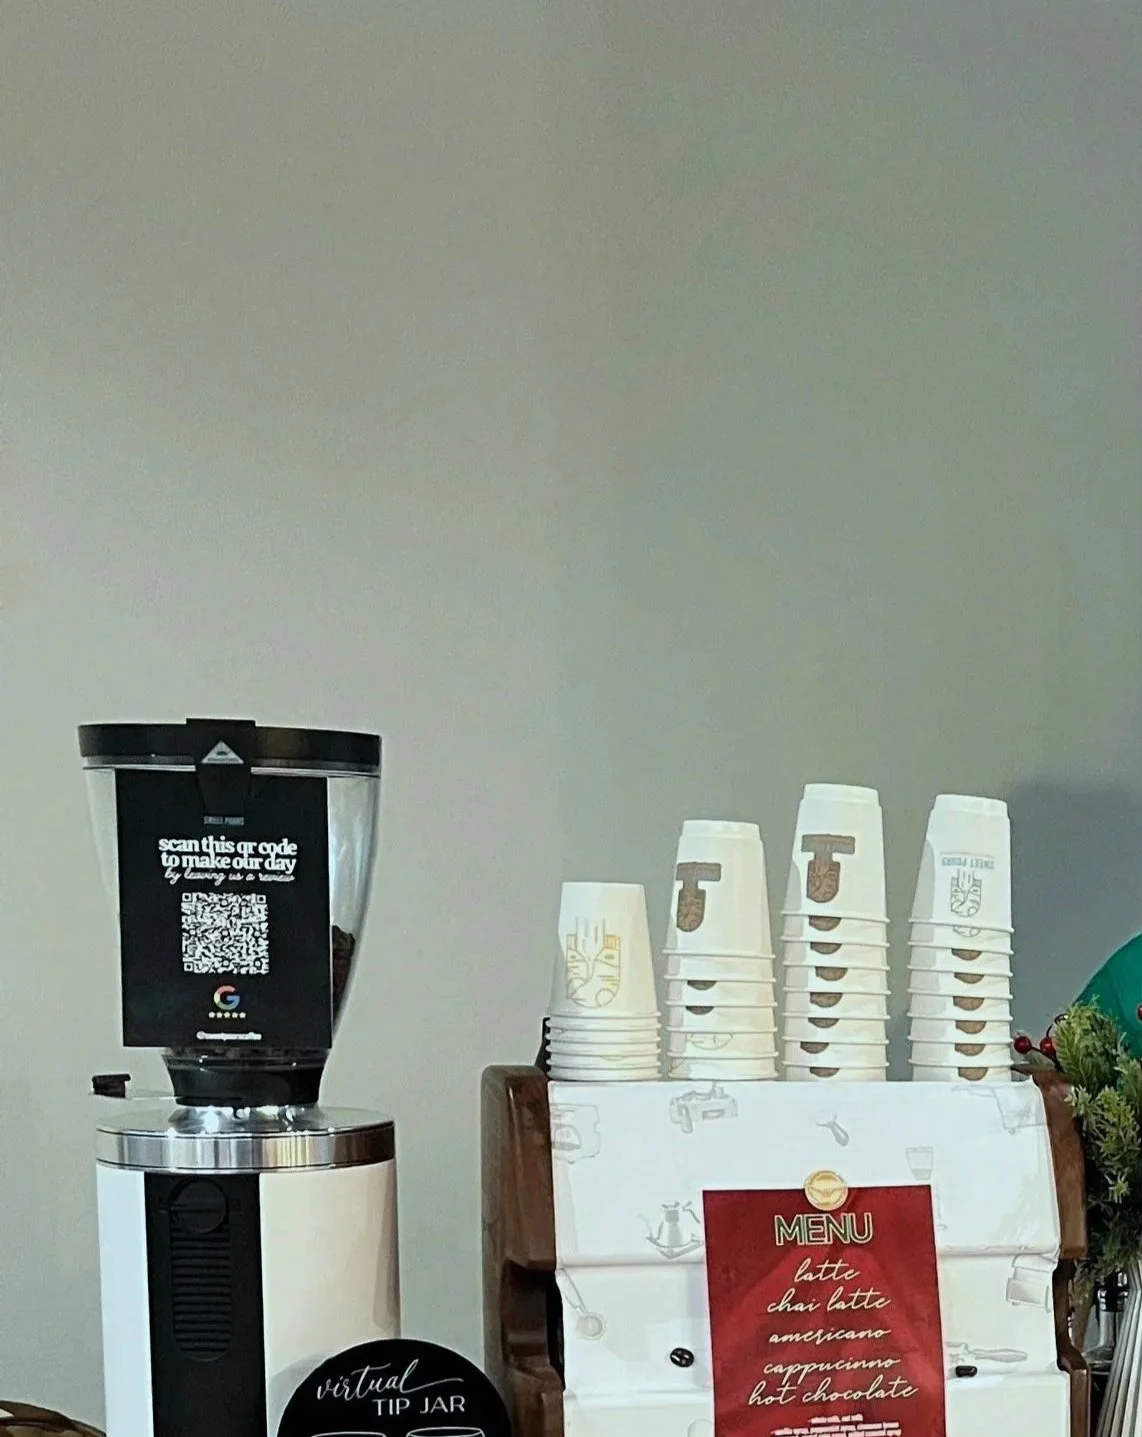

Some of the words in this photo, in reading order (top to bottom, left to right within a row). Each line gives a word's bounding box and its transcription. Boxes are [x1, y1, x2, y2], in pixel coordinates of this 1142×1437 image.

[158, 838, 200, 853] scan
[201, 835, 235, 854] this
[236, 841, 258, 858] qr
[258, 838, 298, 856] code
[160, 851, 181, 868] to
[181, 853, 231, 869] make
[232, 856, 264, 870] our
[264, 853, 297, 875] day
[164, 867, 182, 885] by
[228, 872, 244, 882] us
[245, 873, 255, 882] a
[774, 1212, 873, 1246] MENU
[794, 1257, 860, 1283] latte
[767, 1287, 822, 1313] chai
[826, 1286, 892, 1312] latte
[768, 1327, 892, 1346] americano
[316, 1358, 464, 1401] virtual
[748, 1380, 798, 1406] hot
[802, 1373, 919, 1403] chocolate
[372, 1397, 411, 1416] TIP
[419, 1394, 466, 1414] JAR
